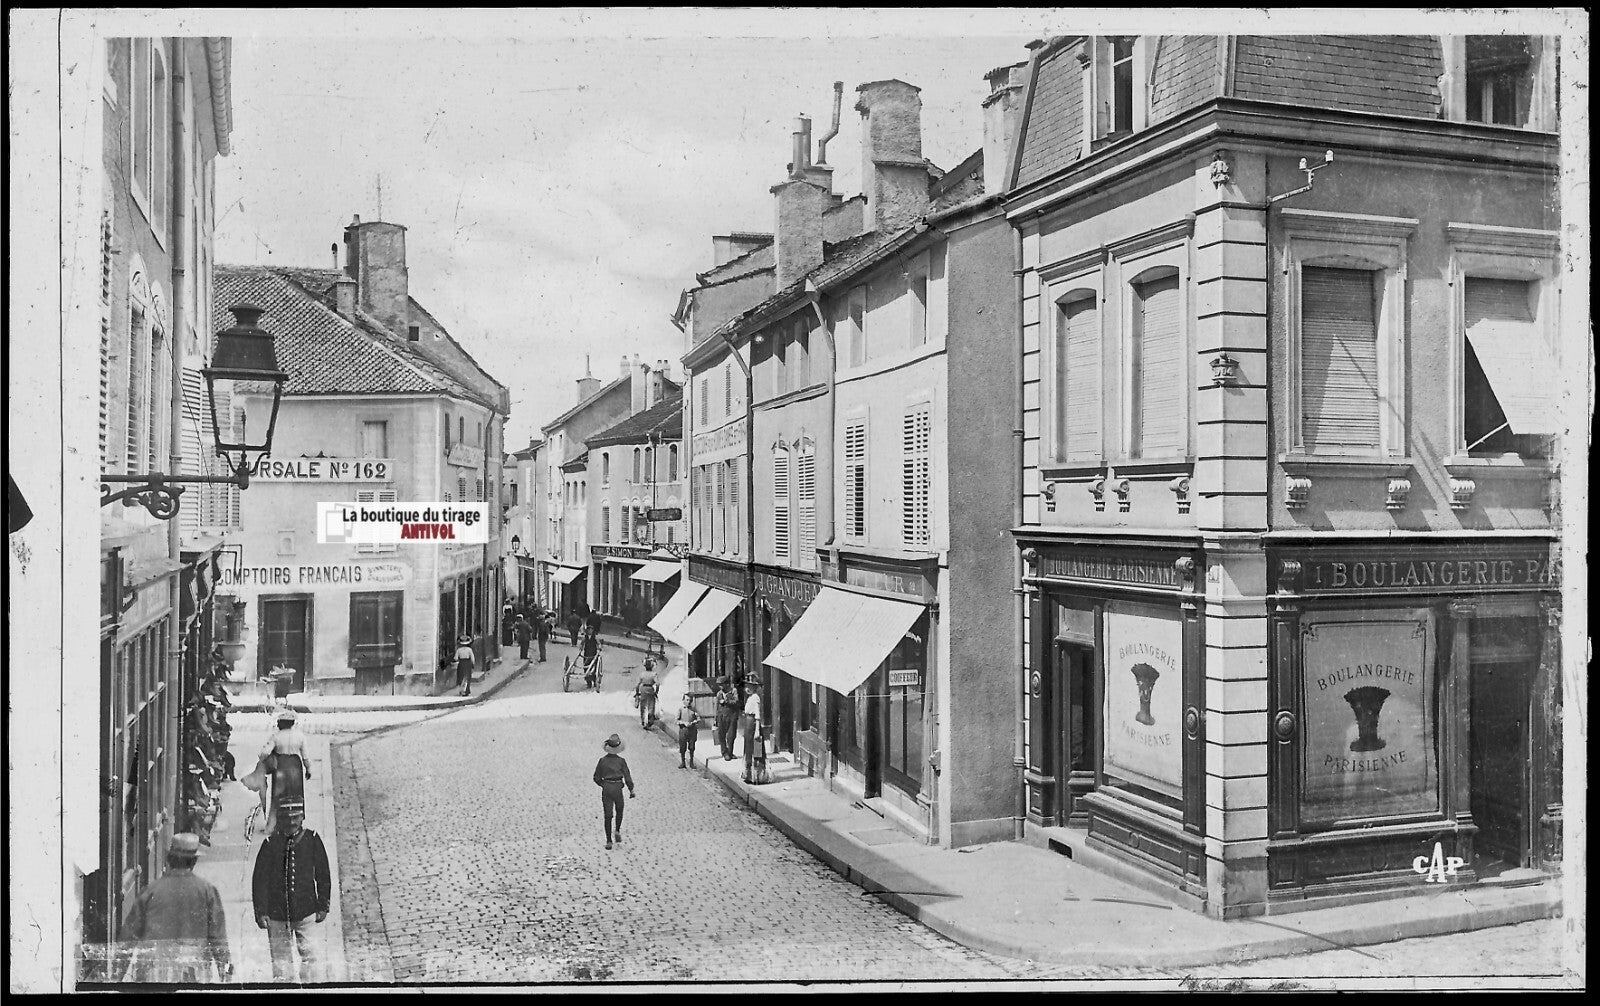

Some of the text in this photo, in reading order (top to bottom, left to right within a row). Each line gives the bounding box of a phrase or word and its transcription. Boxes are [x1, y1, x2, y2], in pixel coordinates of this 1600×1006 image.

[353, 461, 387, 479] 162
[299, 565, 362, 584] FRANCAIS
[1050, 555, 1112, 579] BOULANGERIE
[1116, 558, 1177, 585] PARISIENNE
[1331, 560, 1513, 588] BOULANGERIE
[1119, 643, 1176, 671] BOULANGERIE
[889, 672, 918, 683] COIFFEUR
[1317, 663, 1414, 691] BOULANGERIE
[1121, 720, 1172, 747] PARISIENNE
[1324, 750, 1408, 773] PARISIENNE
